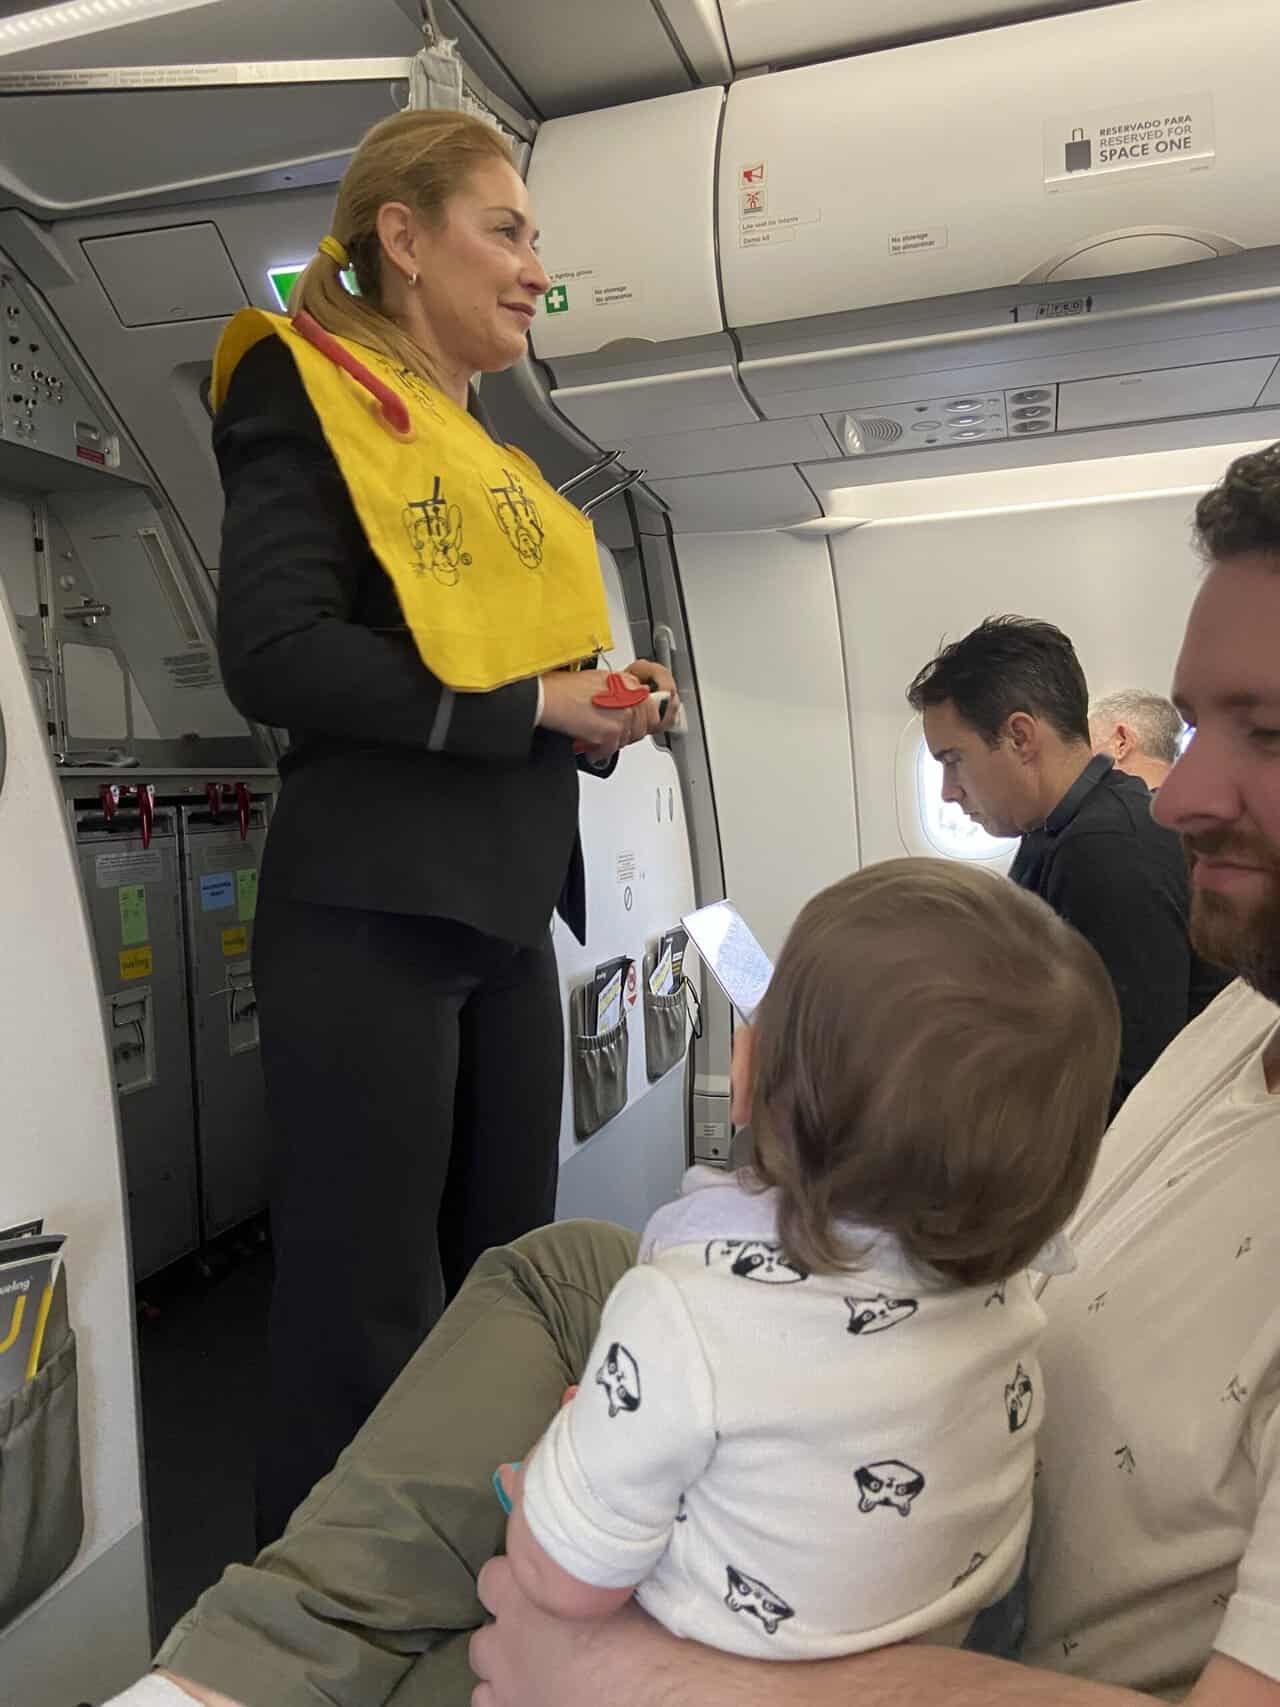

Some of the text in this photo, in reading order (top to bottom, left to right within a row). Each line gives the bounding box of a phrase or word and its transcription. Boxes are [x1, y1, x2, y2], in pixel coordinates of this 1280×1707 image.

[1100, 114, 1193, 137] RESERVADO PARA
[1100, 124, 1193, 148] RESERVED FOR
[1100, 136, 1192, 162] SPACE ONE
[0, 1279, 30, 1296] ueling
